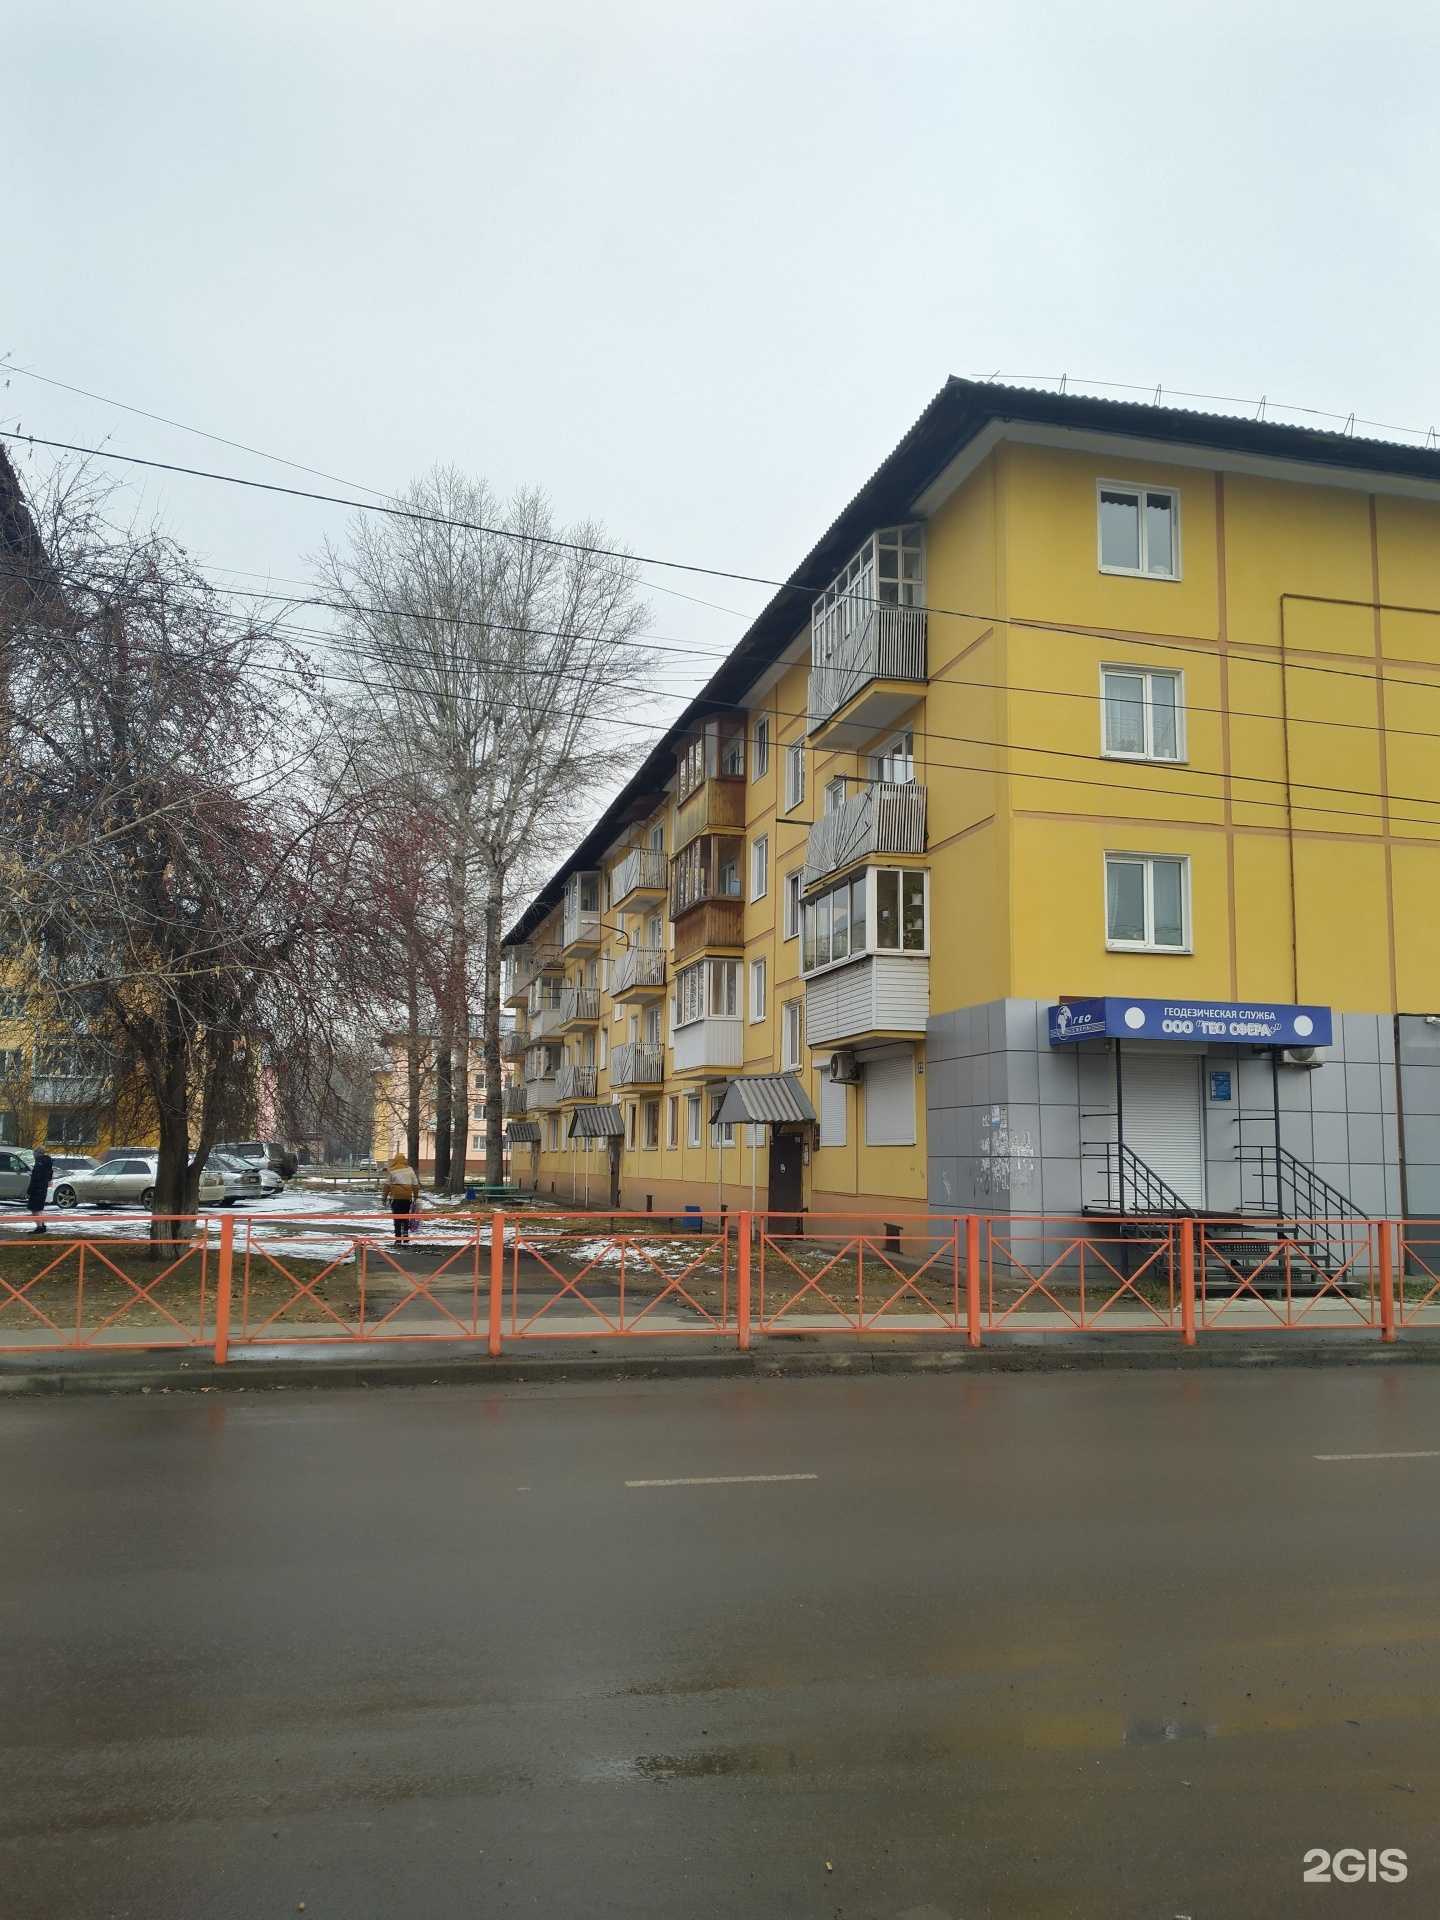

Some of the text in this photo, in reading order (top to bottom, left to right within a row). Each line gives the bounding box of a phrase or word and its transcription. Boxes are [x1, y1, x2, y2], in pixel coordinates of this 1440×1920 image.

[1073, 1014, 1091, 1024] ГЕО
[1164, 1007, 1276, 1020] ГЕОДЕЗИЧЕСКАЯ СЛУЖБА
[1162, 1019, 1193, 1033] ООО
